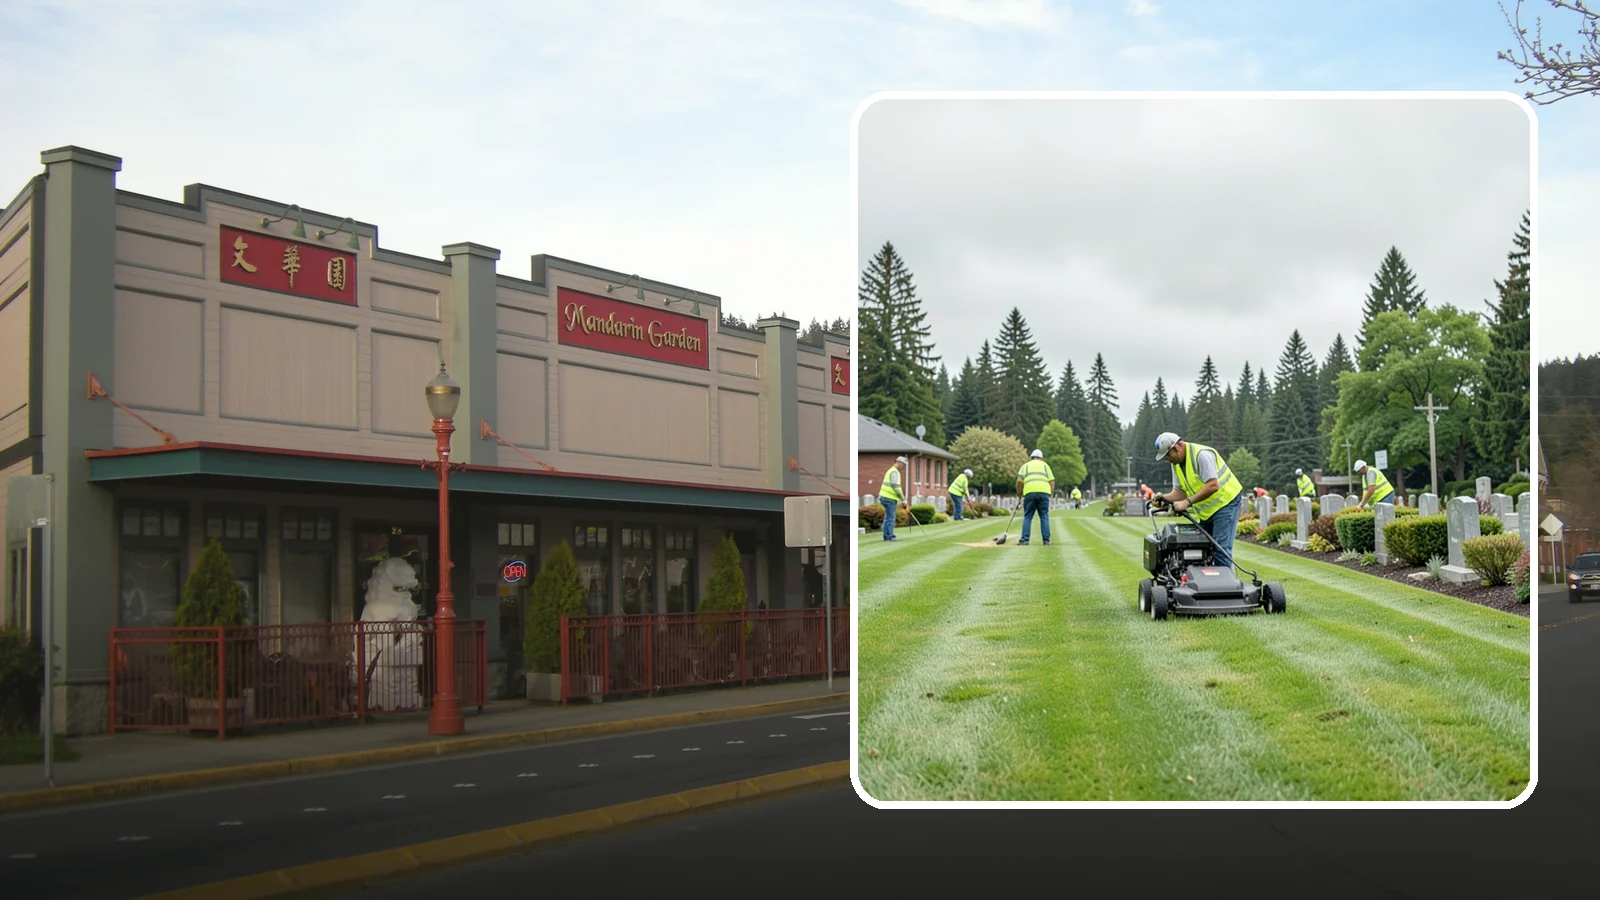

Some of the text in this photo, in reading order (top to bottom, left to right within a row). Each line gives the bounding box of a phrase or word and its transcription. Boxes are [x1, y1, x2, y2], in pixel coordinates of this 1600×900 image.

[231, 236, 346, 290] 文華園
[565, 302, 702, 352] Mandarin Garden
[503, 565, 527, 578] OPEN
